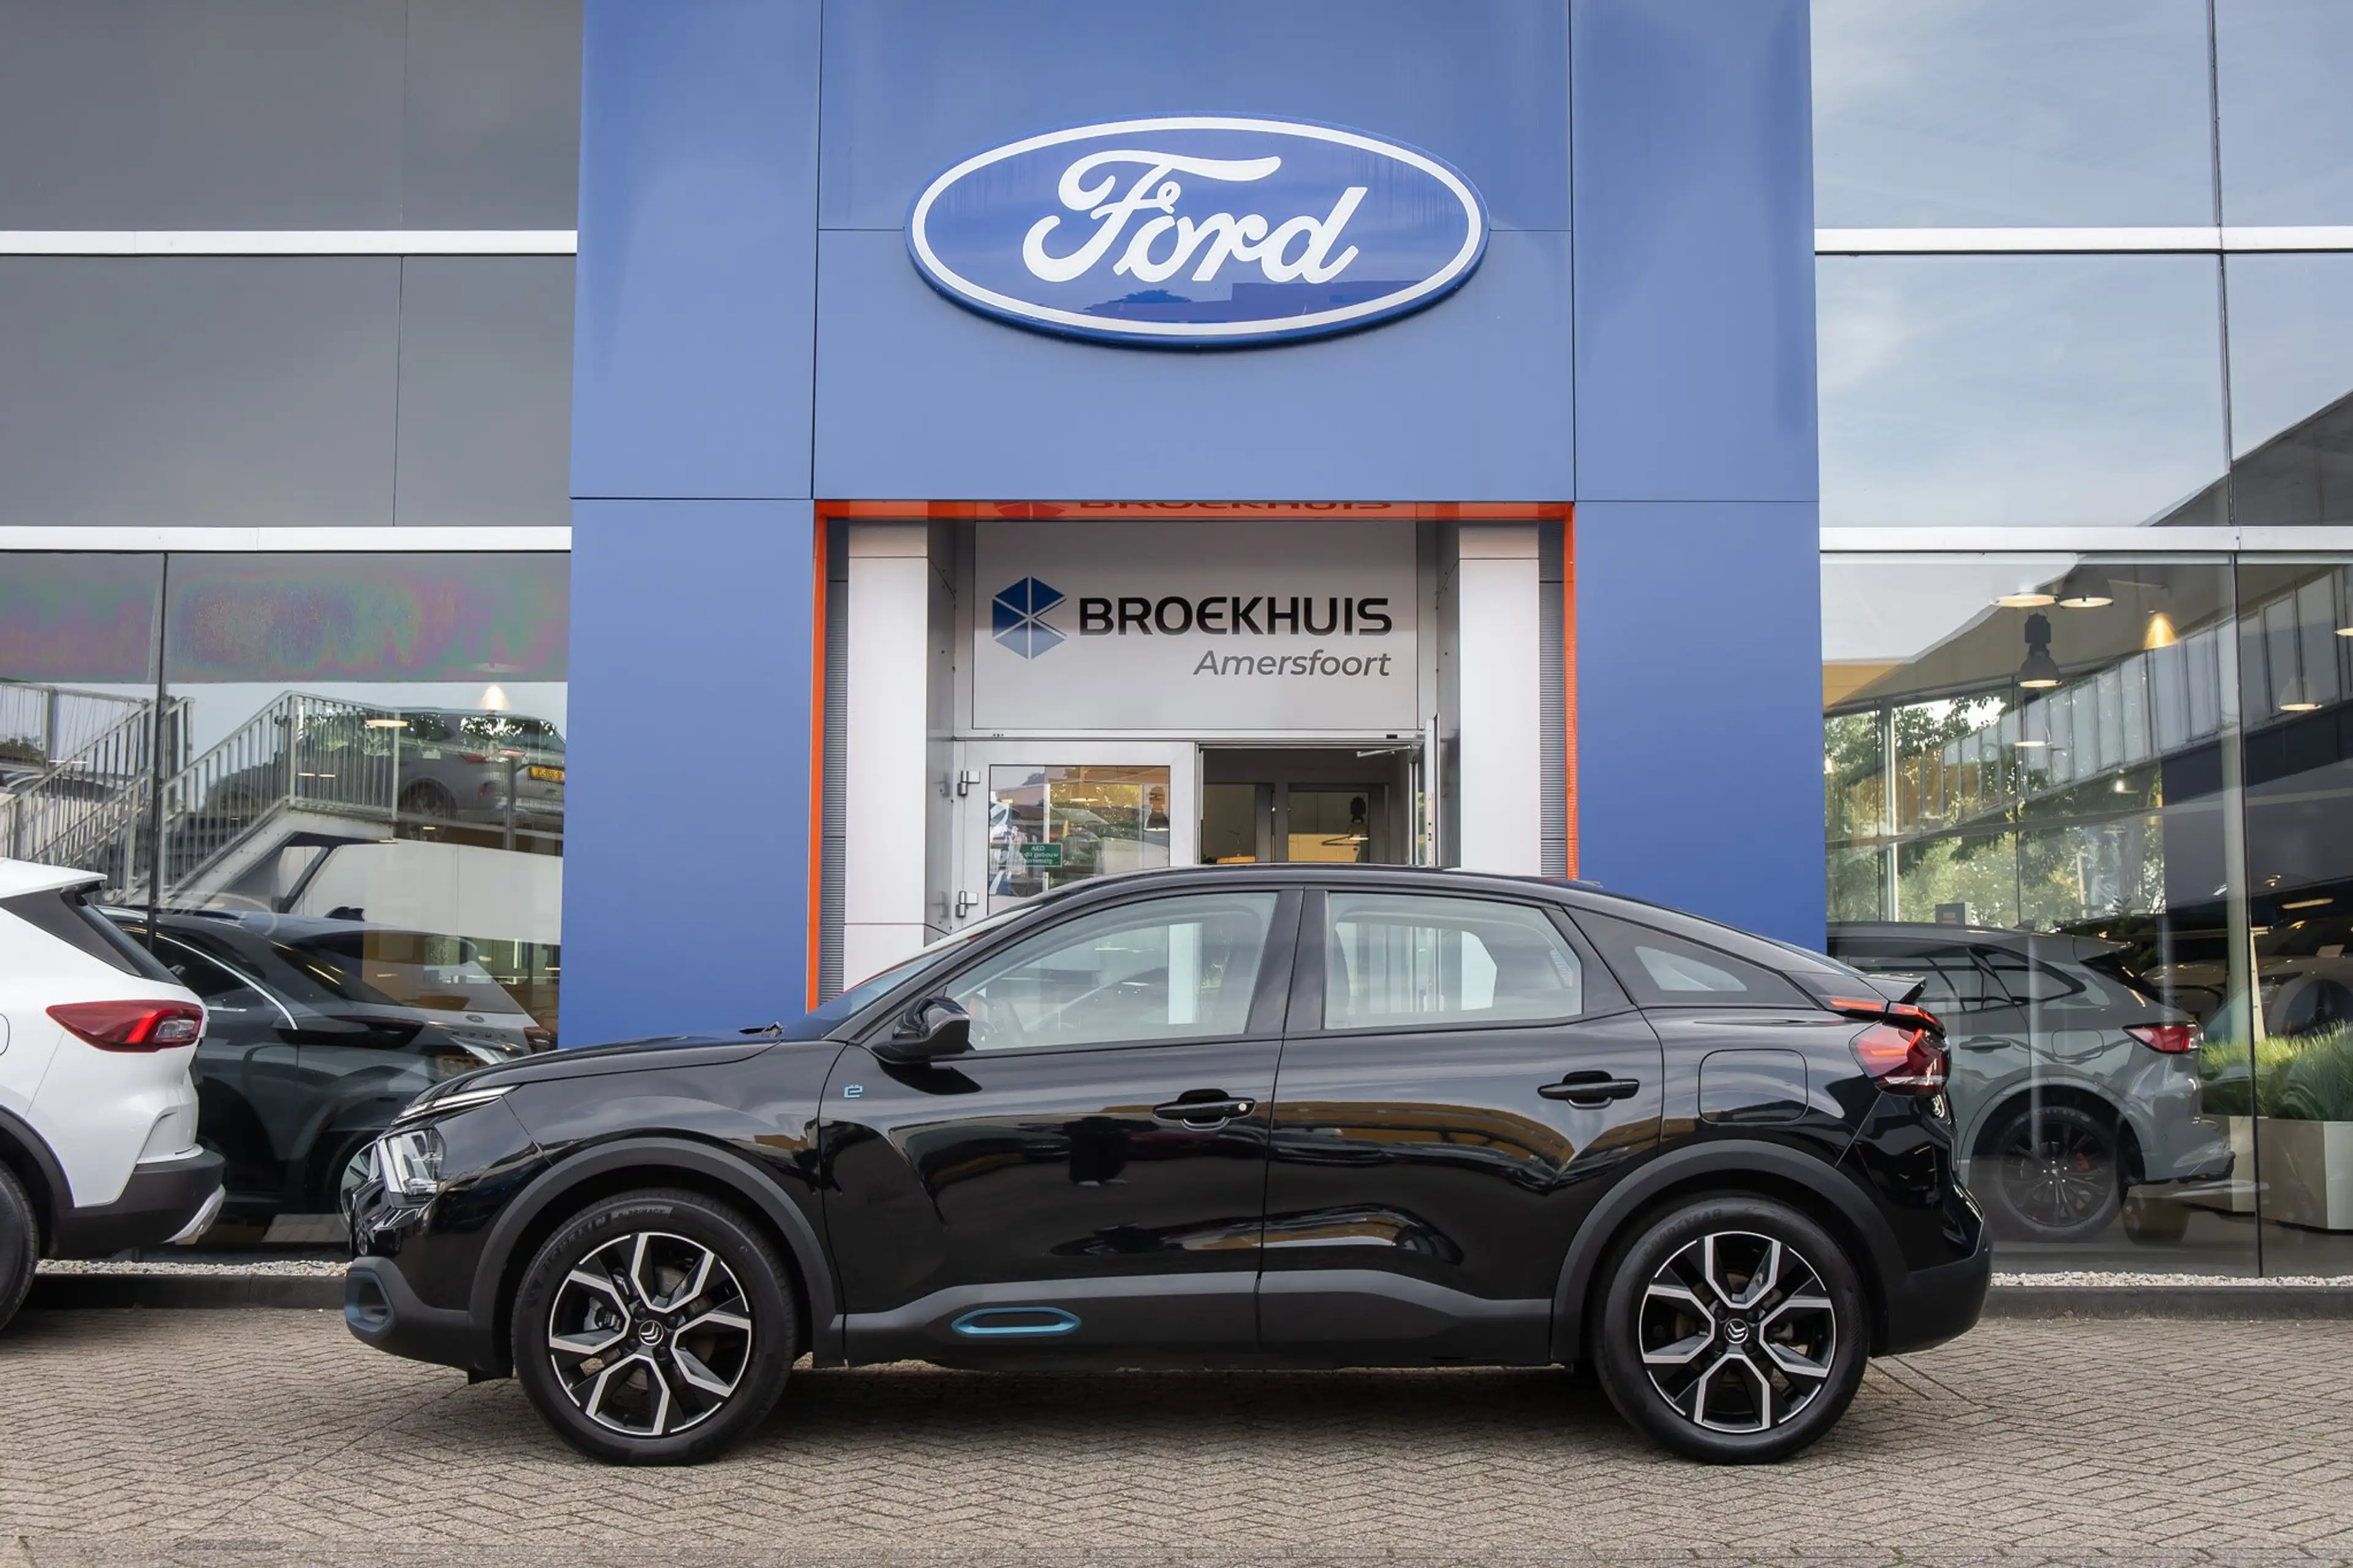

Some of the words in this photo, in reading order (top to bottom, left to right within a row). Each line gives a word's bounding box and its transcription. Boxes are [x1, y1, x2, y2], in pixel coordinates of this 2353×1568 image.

[1022, 150, 1368, 283] Ford
[1079, 596, 1392, 636] BROEKHUIS
[1193, 649, 1392, 676] Amersfoort
